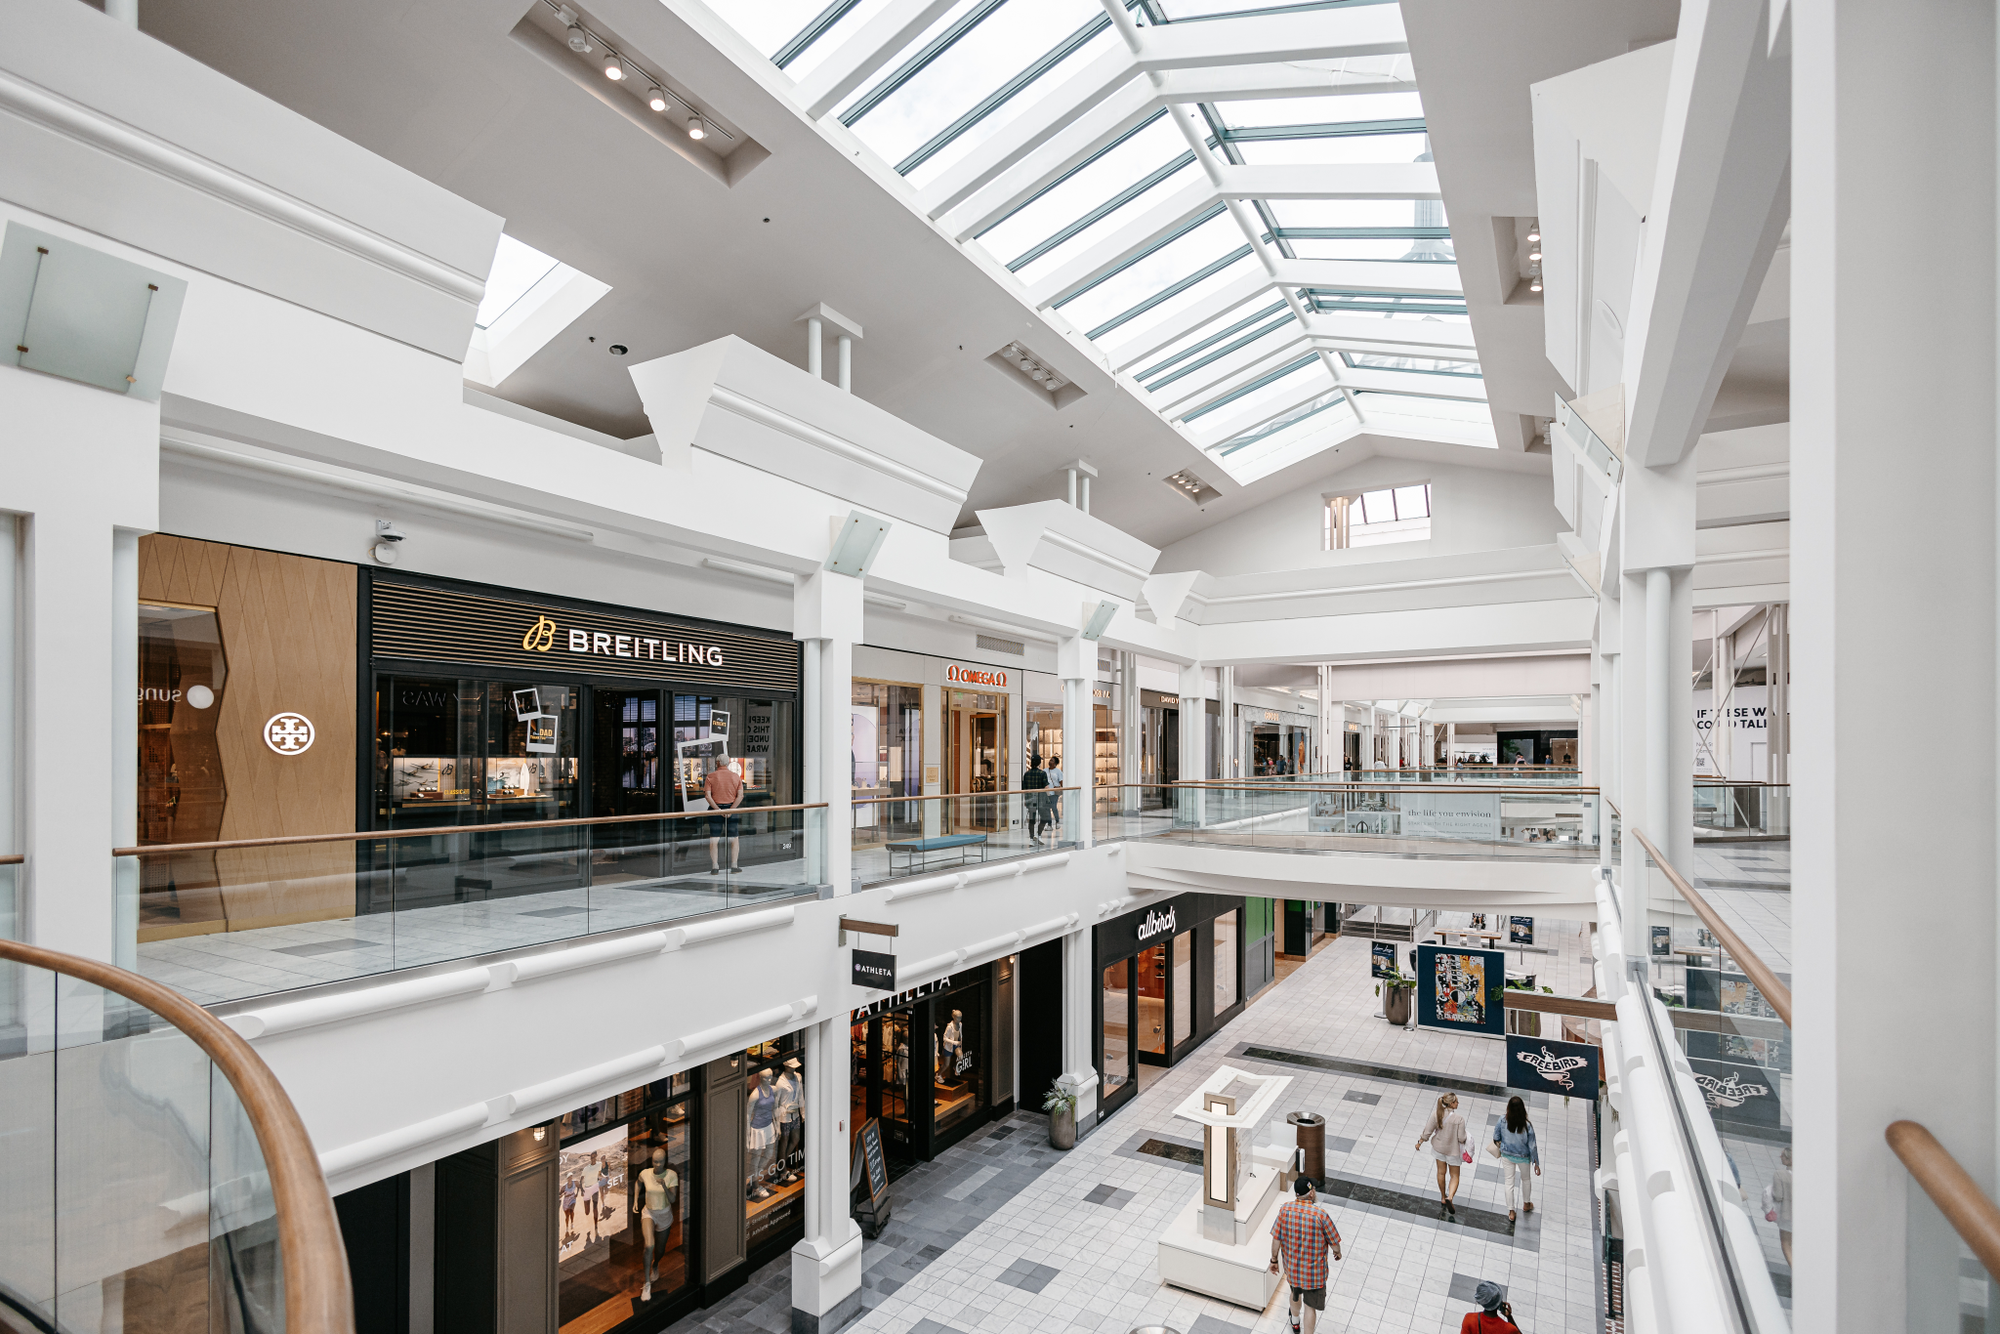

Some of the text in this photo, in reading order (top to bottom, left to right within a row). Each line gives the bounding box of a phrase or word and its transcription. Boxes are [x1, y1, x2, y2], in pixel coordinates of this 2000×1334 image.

[568, 629, 723, 666] BREITLING
[961, 669, 995, 685] OMEGA
[1697, 710, 1707, 718] IF
[539, 728, 552, 736] DAD
[1424, 809, 1436, 817] life
[1456, 810, 1491, 818] envision
[1138, 906, 1176, 940] allbirds
[861, 965, 892, 977] ATHLETA
[956, 1056, 972, 1074] GIRL
[1523, 1055, 1578, 1070] FREEBIRD
[768, 1159, 785, 1176] GO
[607, 1173, 624, 1189] SET
